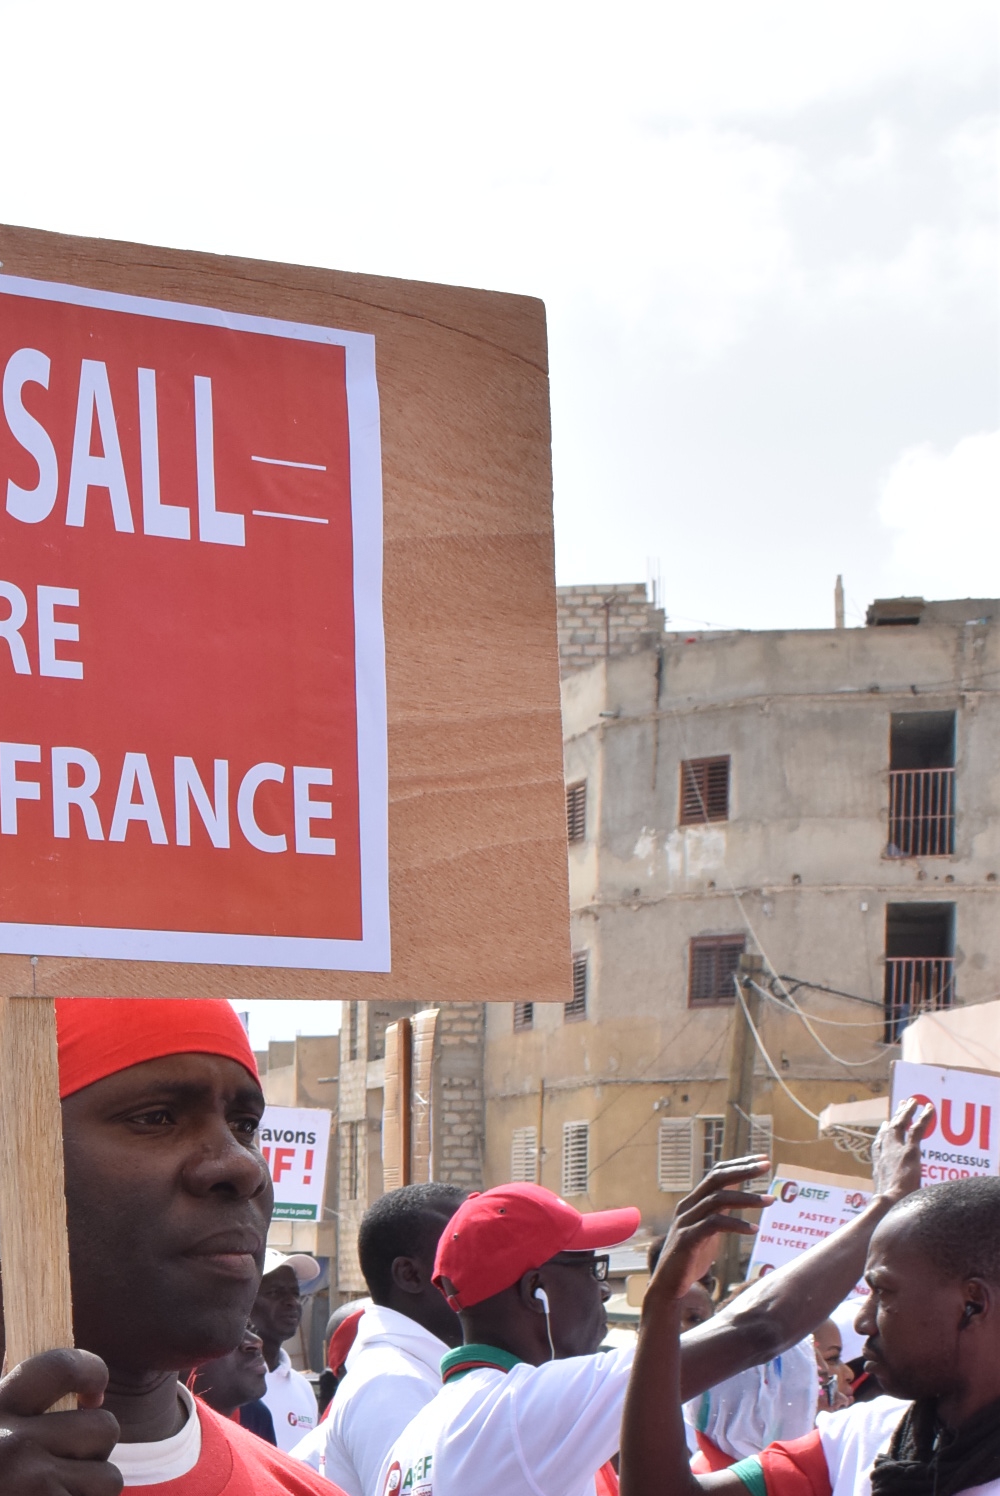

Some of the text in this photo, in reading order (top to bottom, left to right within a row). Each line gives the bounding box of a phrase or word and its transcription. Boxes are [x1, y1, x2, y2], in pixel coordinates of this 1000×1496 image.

[905, 1093, 991, 1150] OUI
[261, 1128, 317, 1145] avons
[928, 1150, 991, 1169] PROCESSUS
[798, 1211, 837, 1225] PASTEF
[771, 1221, 831, 1239] DEPARTEME
